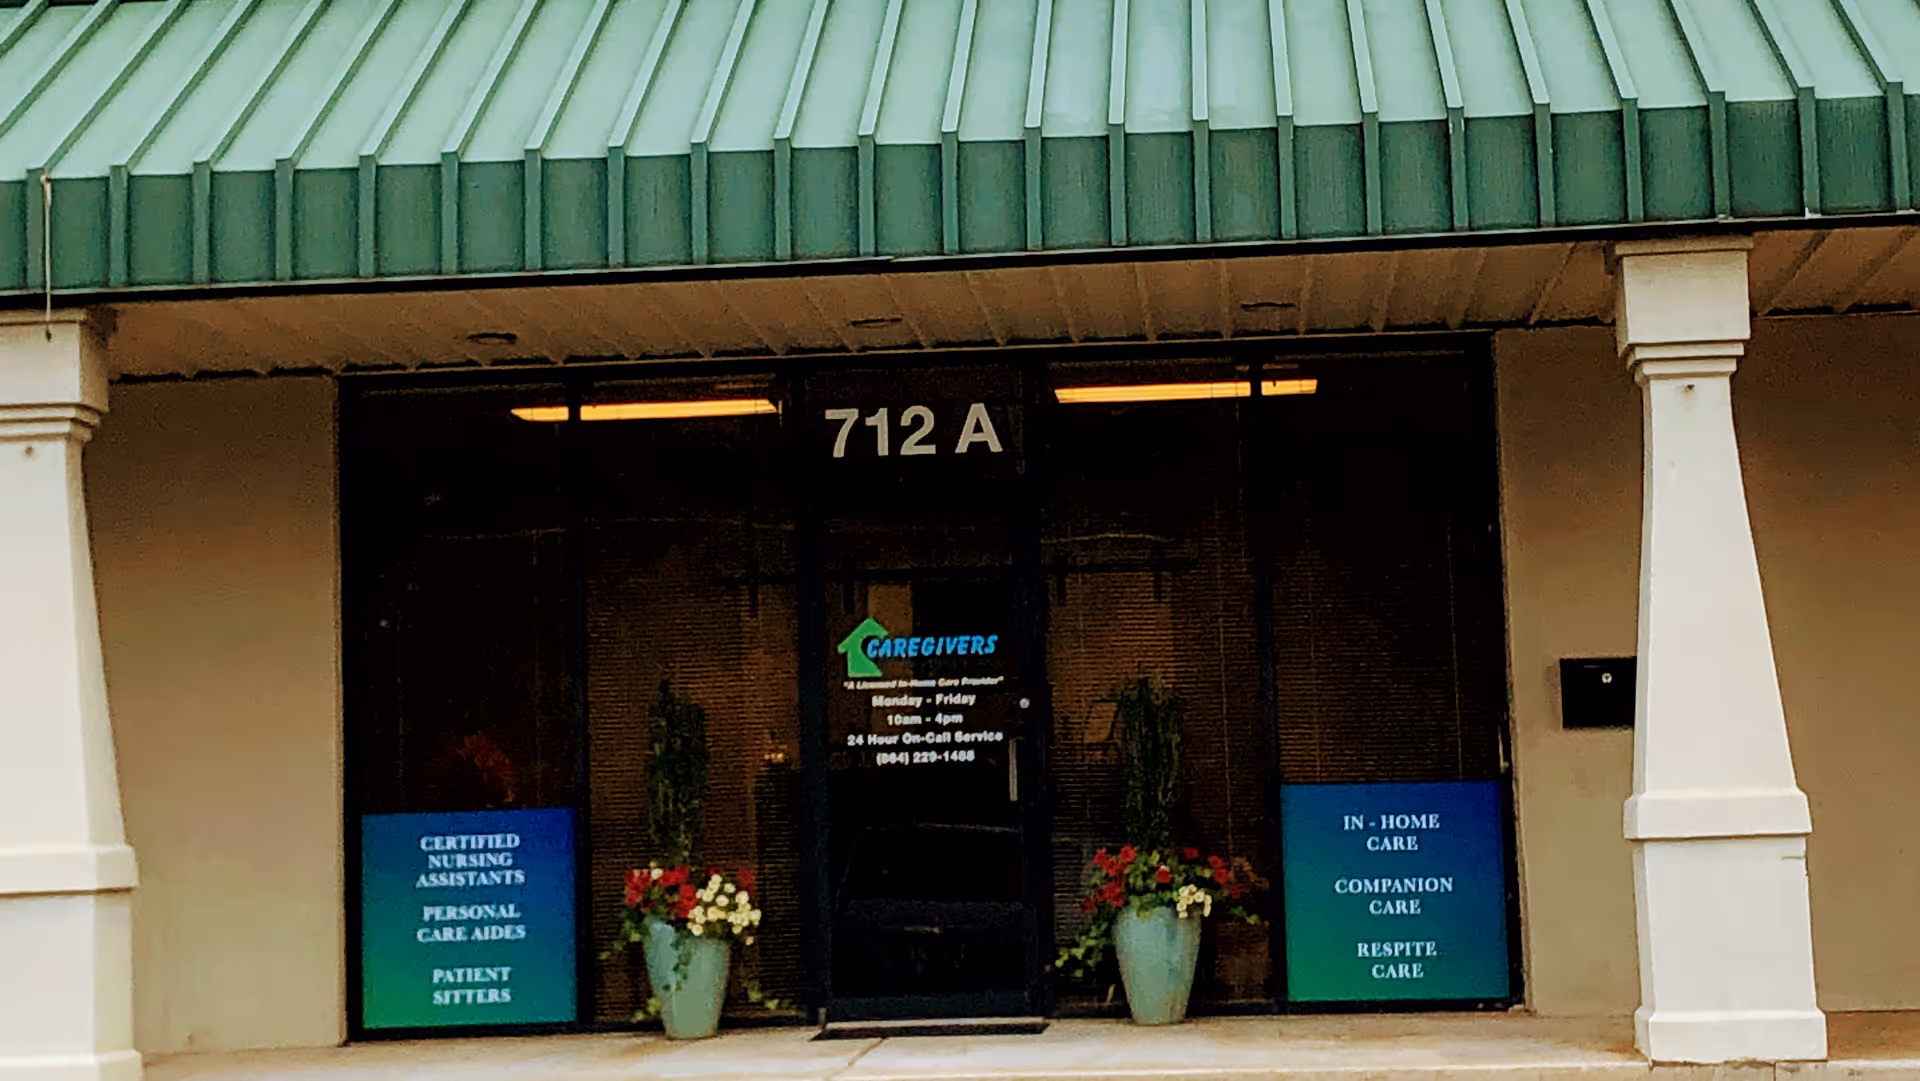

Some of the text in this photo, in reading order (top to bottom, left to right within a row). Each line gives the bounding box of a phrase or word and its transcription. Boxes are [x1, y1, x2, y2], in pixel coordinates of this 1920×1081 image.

[825, 403, 1003, 458] 712 A
[867, 635, 998, 658] CAREGIVERS
[872, 694, 923, 708] Monday
[936, 693, 976, 705] Friday
[887, 714, 922, 725] 10am
[935, 713, 963, 726] 4pm
[847, 731, 1003, 746] 24 Hour On-Call Service
[1343, 815, 1364, 830] IN
[1381, 813, 1440, 829] HOME
[421, 834, 520, 850] CERTIFIED
[1366, 835, 1419, 851] CARE
[429, 853, 512, 868] NURSING
[417, 870, 524, 887] ASSISTANTS
[1334, 877, 1453, 894] COMPANION
[424, 904, 520, 921] PERSONAL
[1369, 899, 1421, 915] CARE
[417, 925, 525, 942] CARE AIDES
[1357, 941, 1437, 957] RESPITE
[433, 967, 511, 983] PATIENT
[1371, 963, 1424, 979] CARE
[434, 989, 511, 1004] SITTERS
